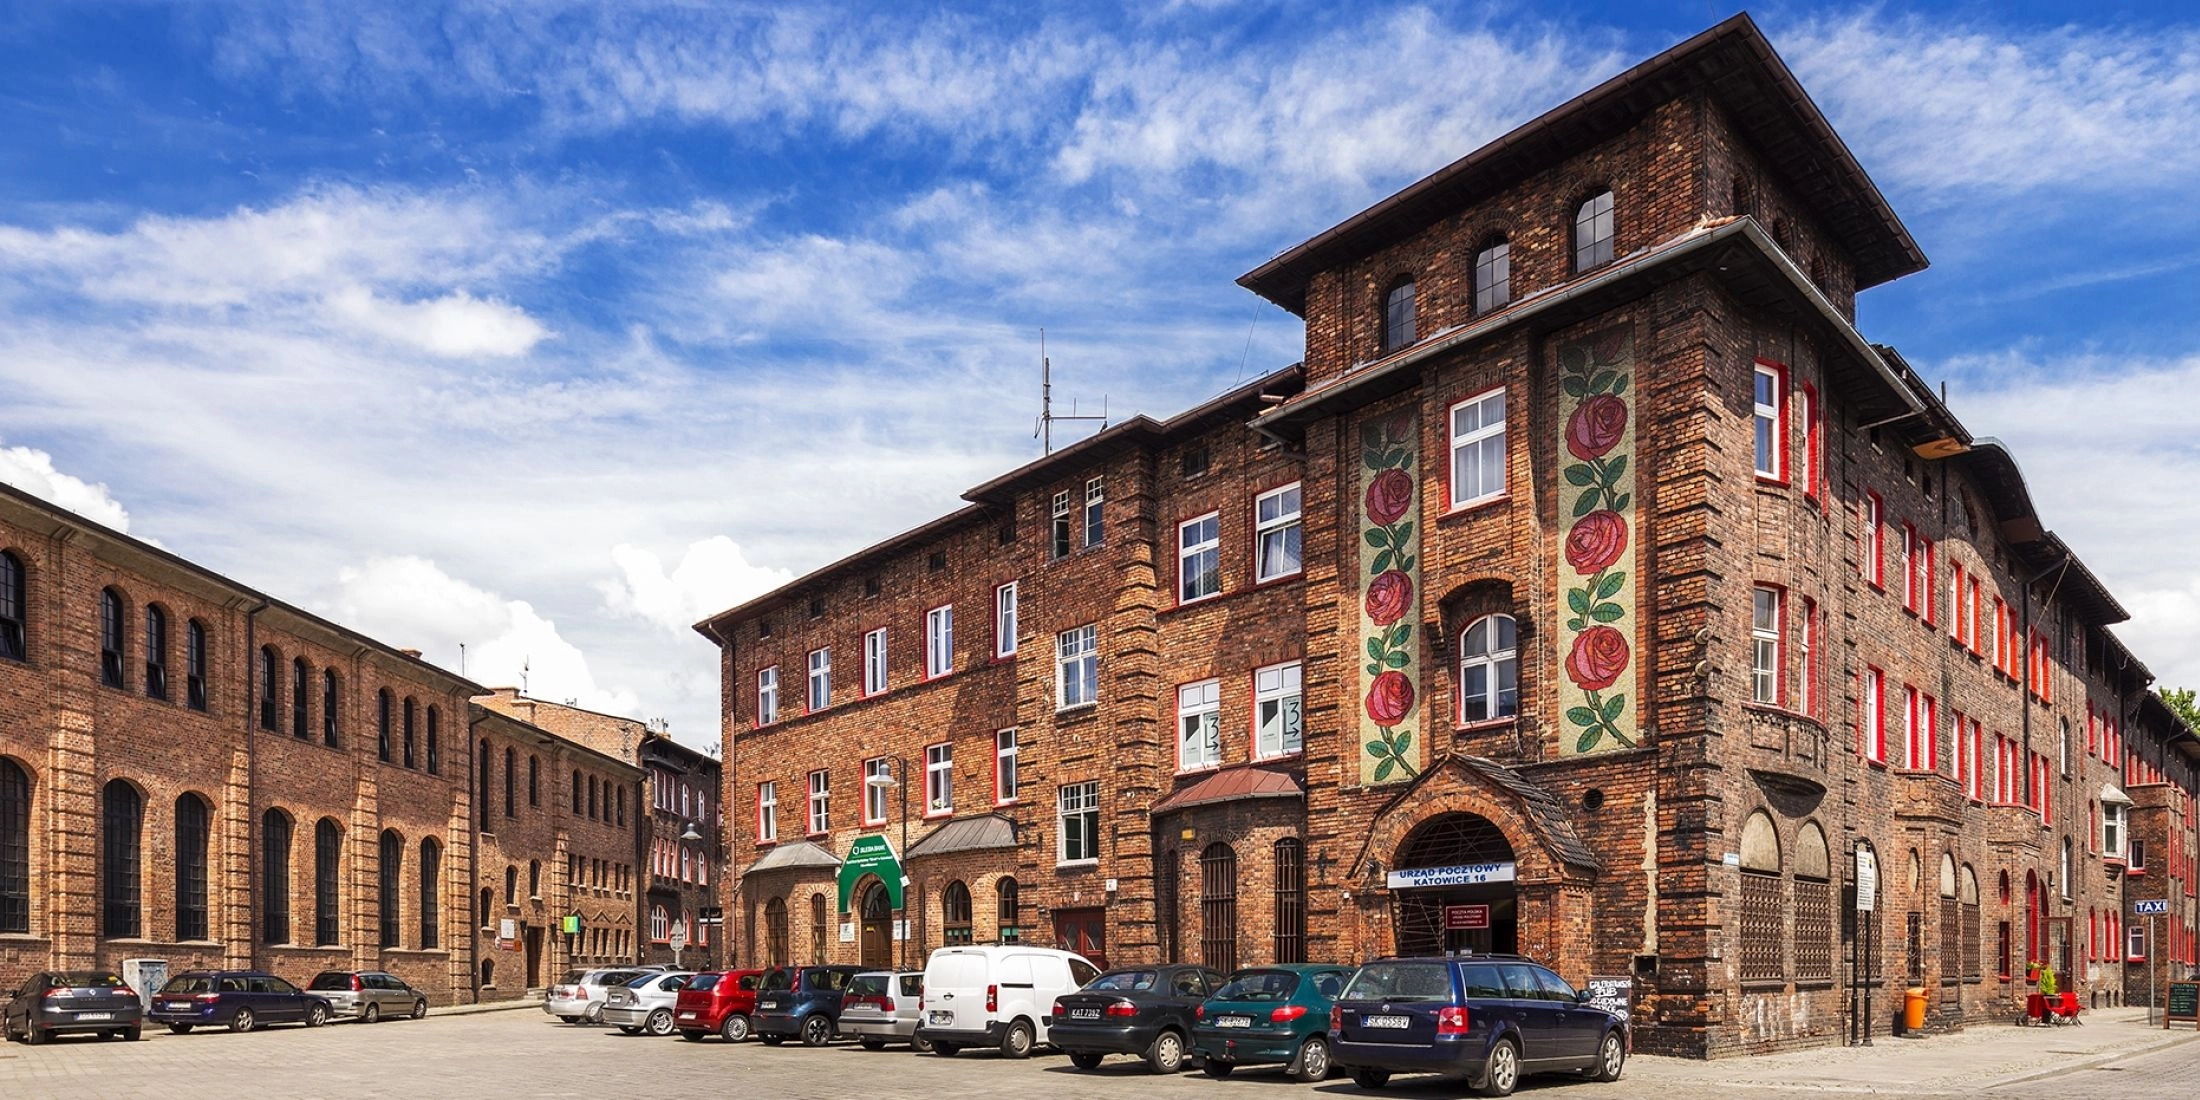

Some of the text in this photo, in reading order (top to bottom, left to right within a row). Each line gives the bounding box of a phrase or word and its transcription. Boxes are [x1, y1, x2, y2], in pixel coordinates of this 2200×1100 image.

[1400, 864, 1501, 879] URZĄD POCZTOWY
[1414, 874, 1486, 886] KATOWICE 16
[2137, 901, 2167, 912] TAXI
